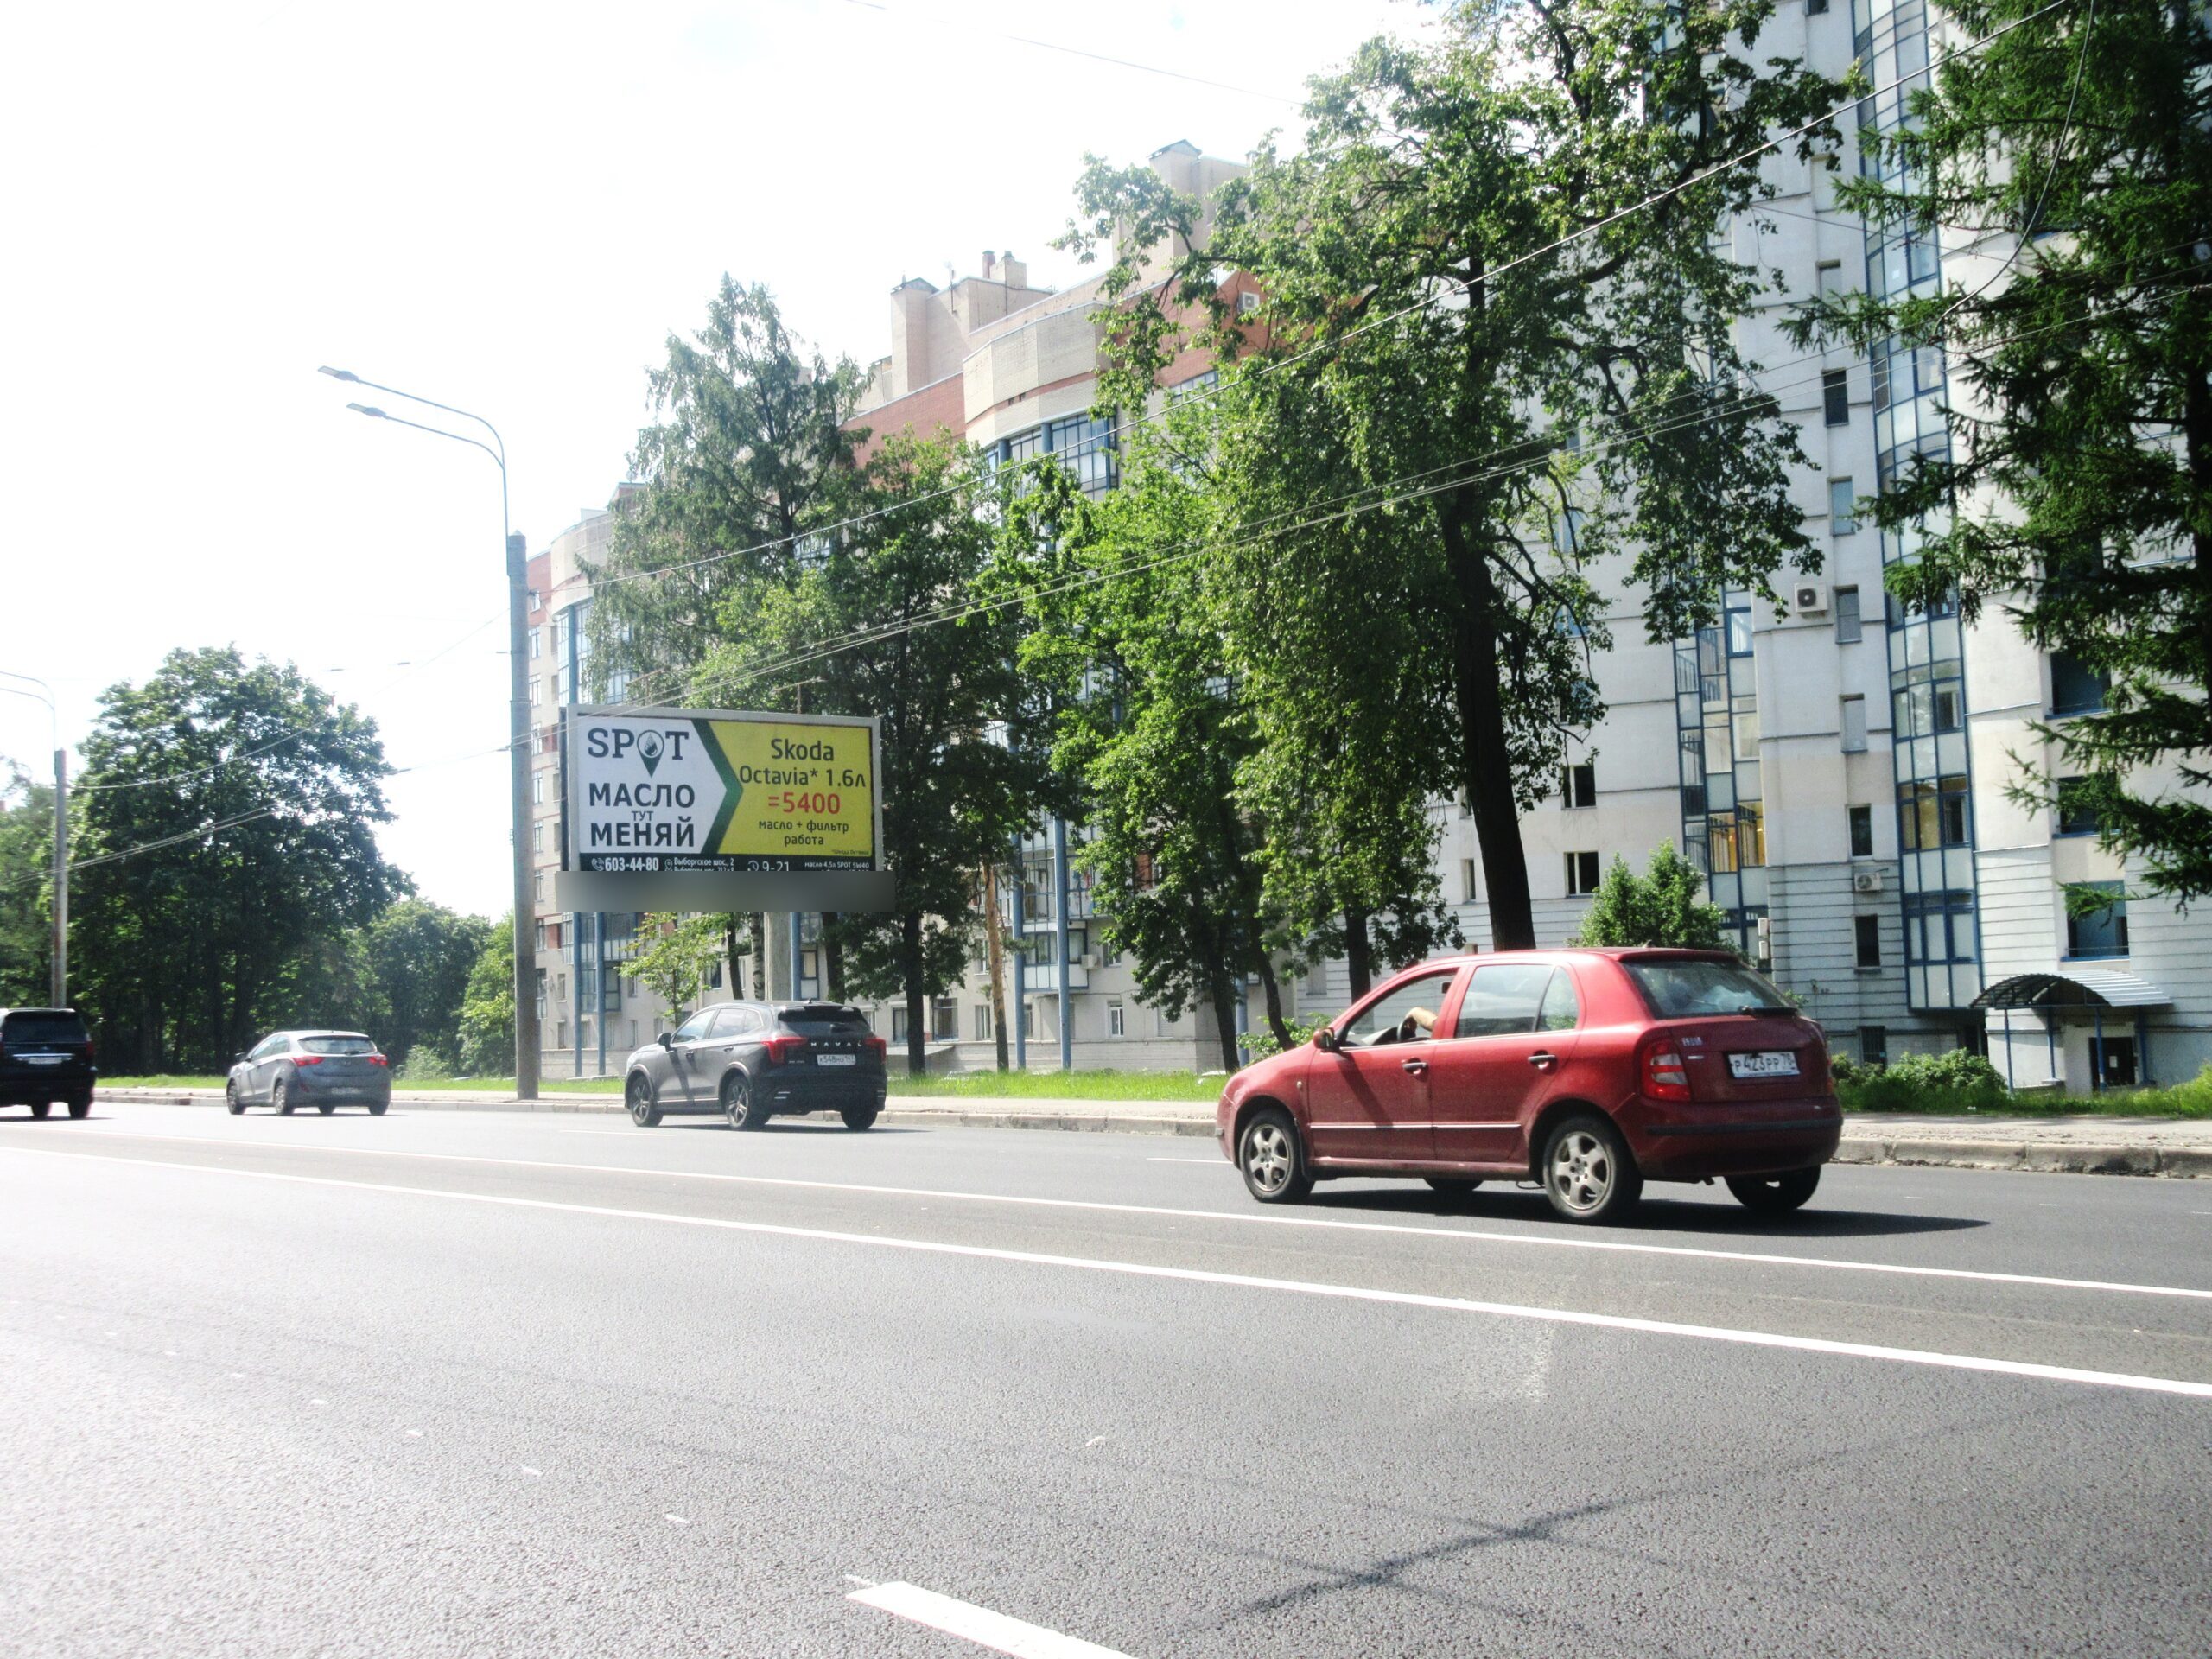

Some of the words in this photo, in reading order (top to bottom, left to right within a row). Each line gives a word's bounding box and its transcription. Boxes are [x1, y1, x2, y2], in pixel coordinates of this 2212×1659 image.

[588, 727, 690, 778] SPOT
[770, 738, 835, 761] Skoda
[825, 768, 867, 787] 1.6л
[588, 782, 696, 809] МАСЛО
[768, 791, 841, 814] =5400
[631, 810, 654, 822] ТУТ
[590, 816, 695, 848] МЕНЯЙ
[758, 821, 793, 830] масло
[806, 820, 849, 834] фильтр
[784, 834, 824, 848] работа
[604, 857, 659, 872] 603-44-80
